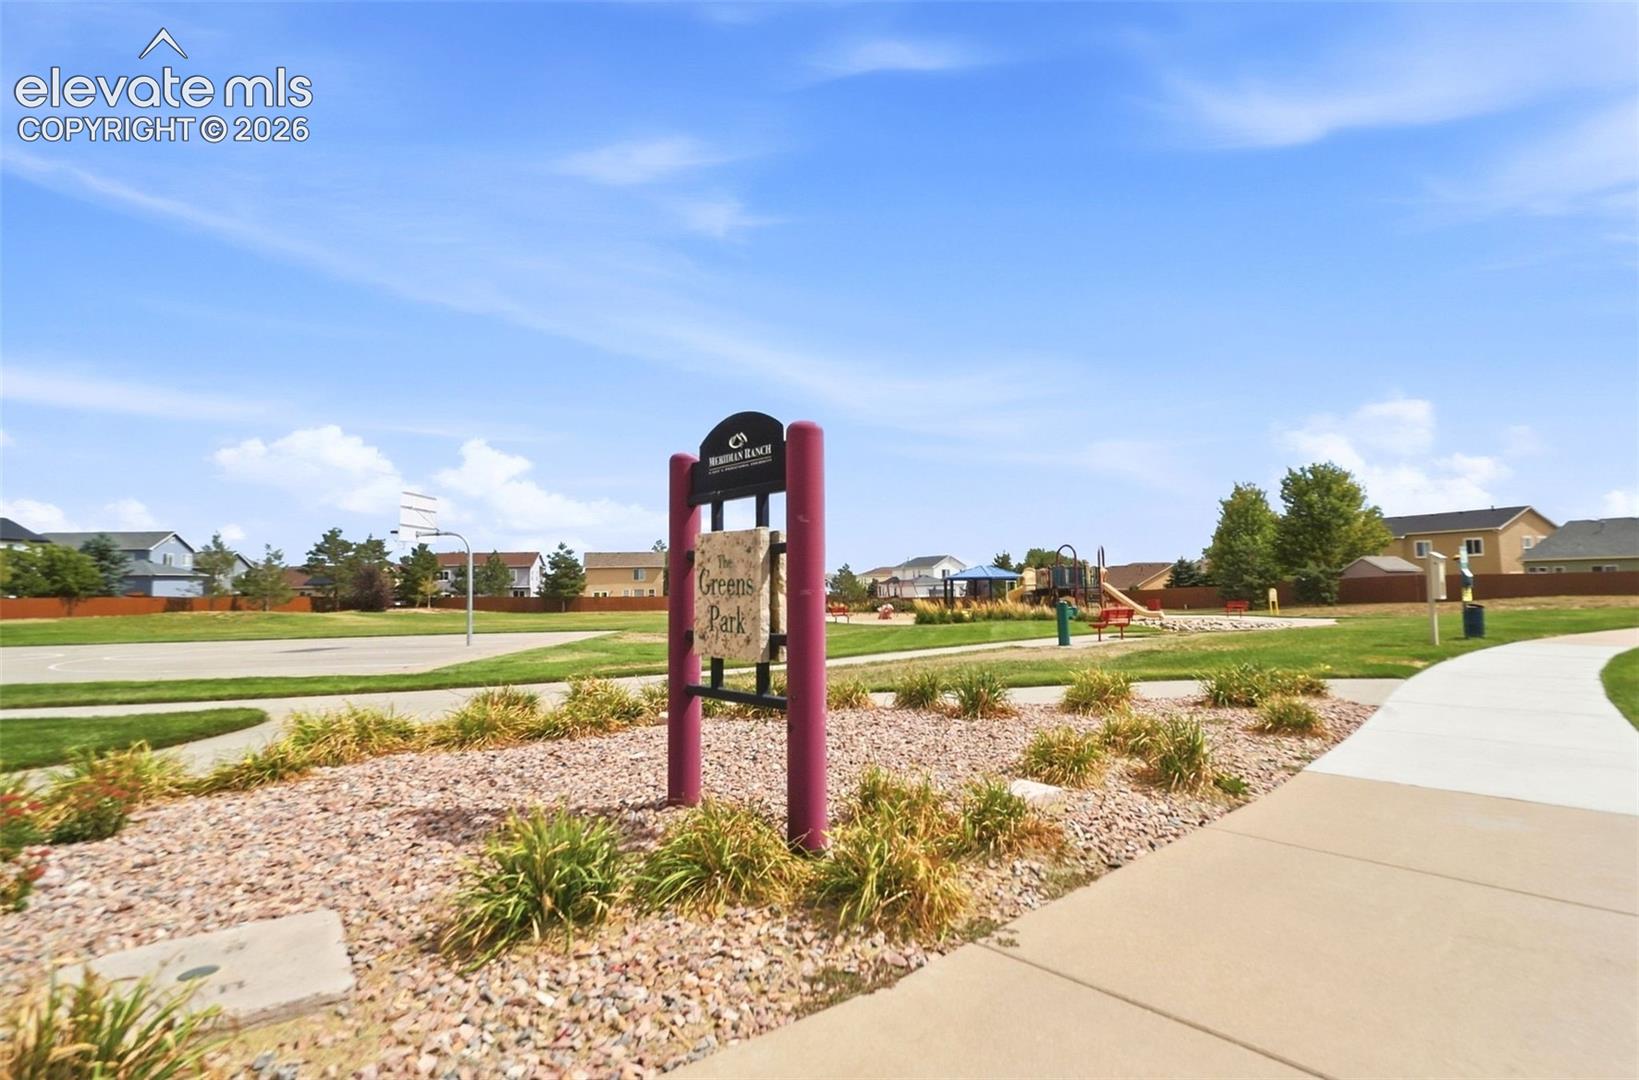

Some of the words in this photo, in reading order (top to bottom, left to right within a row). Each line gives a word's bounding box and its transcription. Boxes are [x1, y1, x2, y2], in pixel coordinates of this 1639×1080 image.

[708, 450, 744, 467] MERIDIAN
[744, 444, 772, 459] RANCH
[717, 554, 733, 569] The
[699, 569, 754, 597] Greens
[708, 605, 745, 635] Park
